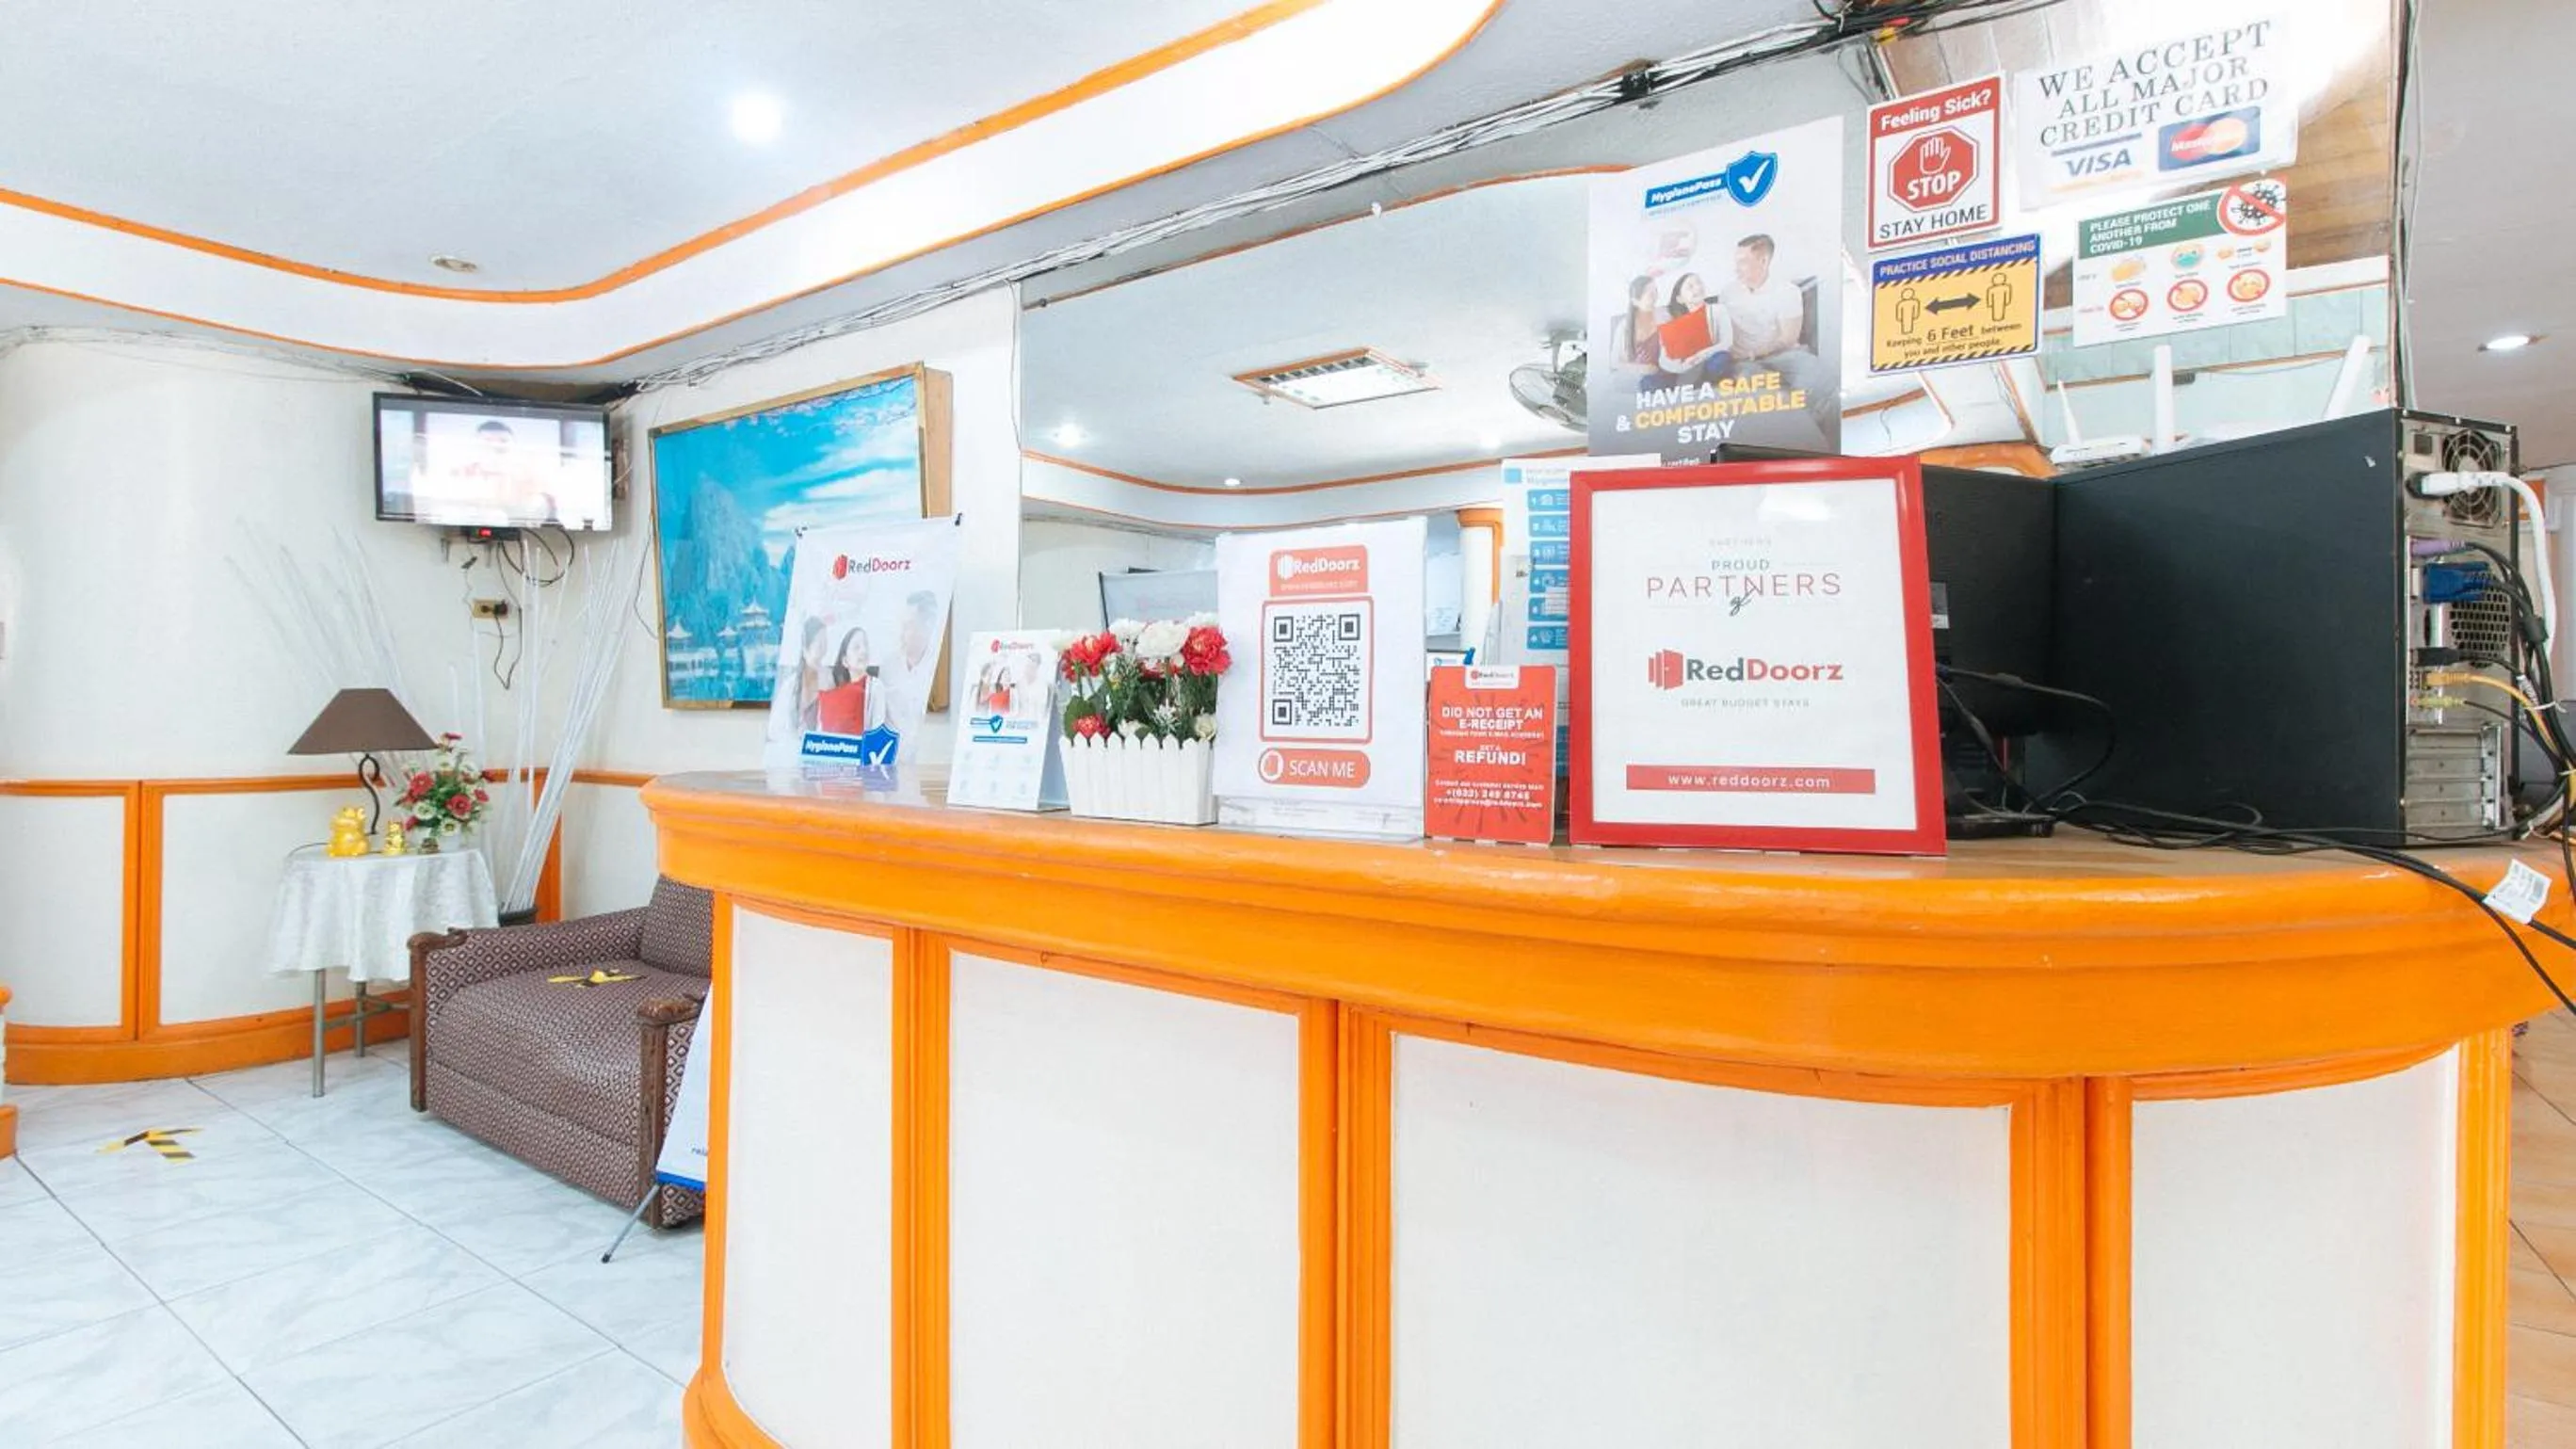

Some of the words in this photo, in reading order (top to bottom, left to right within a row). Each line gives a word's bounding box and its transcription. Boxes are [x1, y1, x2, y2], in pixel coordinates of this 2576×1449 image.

[2038, 65, 2094, 99] WE
[2108, 19, 2272, 84] ACCEPT
[2058, 88, 2119, 120] ALL
[2131, 56, 2249, 103] MAJOR
[1880, 105, 1941, 131] Feeling
[1944, 89, 1992, 116] Sick?
[2039, 102, 2161, 148] CREDIT
[2174, 77, 2269, 117] CARD
[2065, 148, 2133, 177] VISA
[1907, 170, 1962, 201] STOP
[1878, 217, 1925, 239] STAY
[1930, 203, 1988, 230] HOME
[2089, 215, 2132, 233] PLEASE
[2133, 205, 2184, 225] PROTECT
[2186, 200, 2211, 215] ONE
[2089, 225, 2143, 244] ANOTHER
[2144, 218, 2178, 233] FROM
[2089, 236, 2143, 254] COVID-19
[1879, 258, 1929, 278] PRACTICE
[1930, 252, 1968, 268] SOCIAL
[1969, 240, 2036, 262] DISTANCING
[1886, 337, 1923, 347] Keeping
[1926, 330, 1937, 342] 6
[1941, 325, 1974, 340] Feet
[1981, 323, 2022, 334] between
[1904, 349, 1921, 359] you
[1923, 346, 1940, 355] and
[1942, 343, 1966, 352] other
[1635, 383, 1695, 410] HAVE
[1698, 381, 1715, 401] A
[1718, 371, 1781, 397] SAFE
[1615, 414, 1632, 433] &
[1634, 390, 1807, 430] COMFORTABLE
[1677, 420, 1735, 445] STAY
[848, 556, 911, 573] RedDoorz
[1294, 556, 1361, 574] RedDoorz
[1711, 558, 1770, 572] PROUD
[1647, 572, 1842, 600] PARTNERS
[1686, 657, 1844, 682] RedDoorz
[1441, 706, 1462, 718] DID
[1465, 706, 1493, 718] NOT
[1495, 707, 1522, 718] GET
[1523, 707, 1543, 720] AN
[1681, 698, 1717, 708] GREAT
[1721, 698, 1769, 708] BUDGET
[1774, 699, 1811, 708] STAYS
[1458, 718, 1524, 731] E-RECEIPT
[1288, 759, 1330, 778] SCAN
[1332, 760, 1357, 779] ME
[1454, 749, 1526, 765] REFUND!
[1667, 772, 1831, 789] www.reddoorz.com
